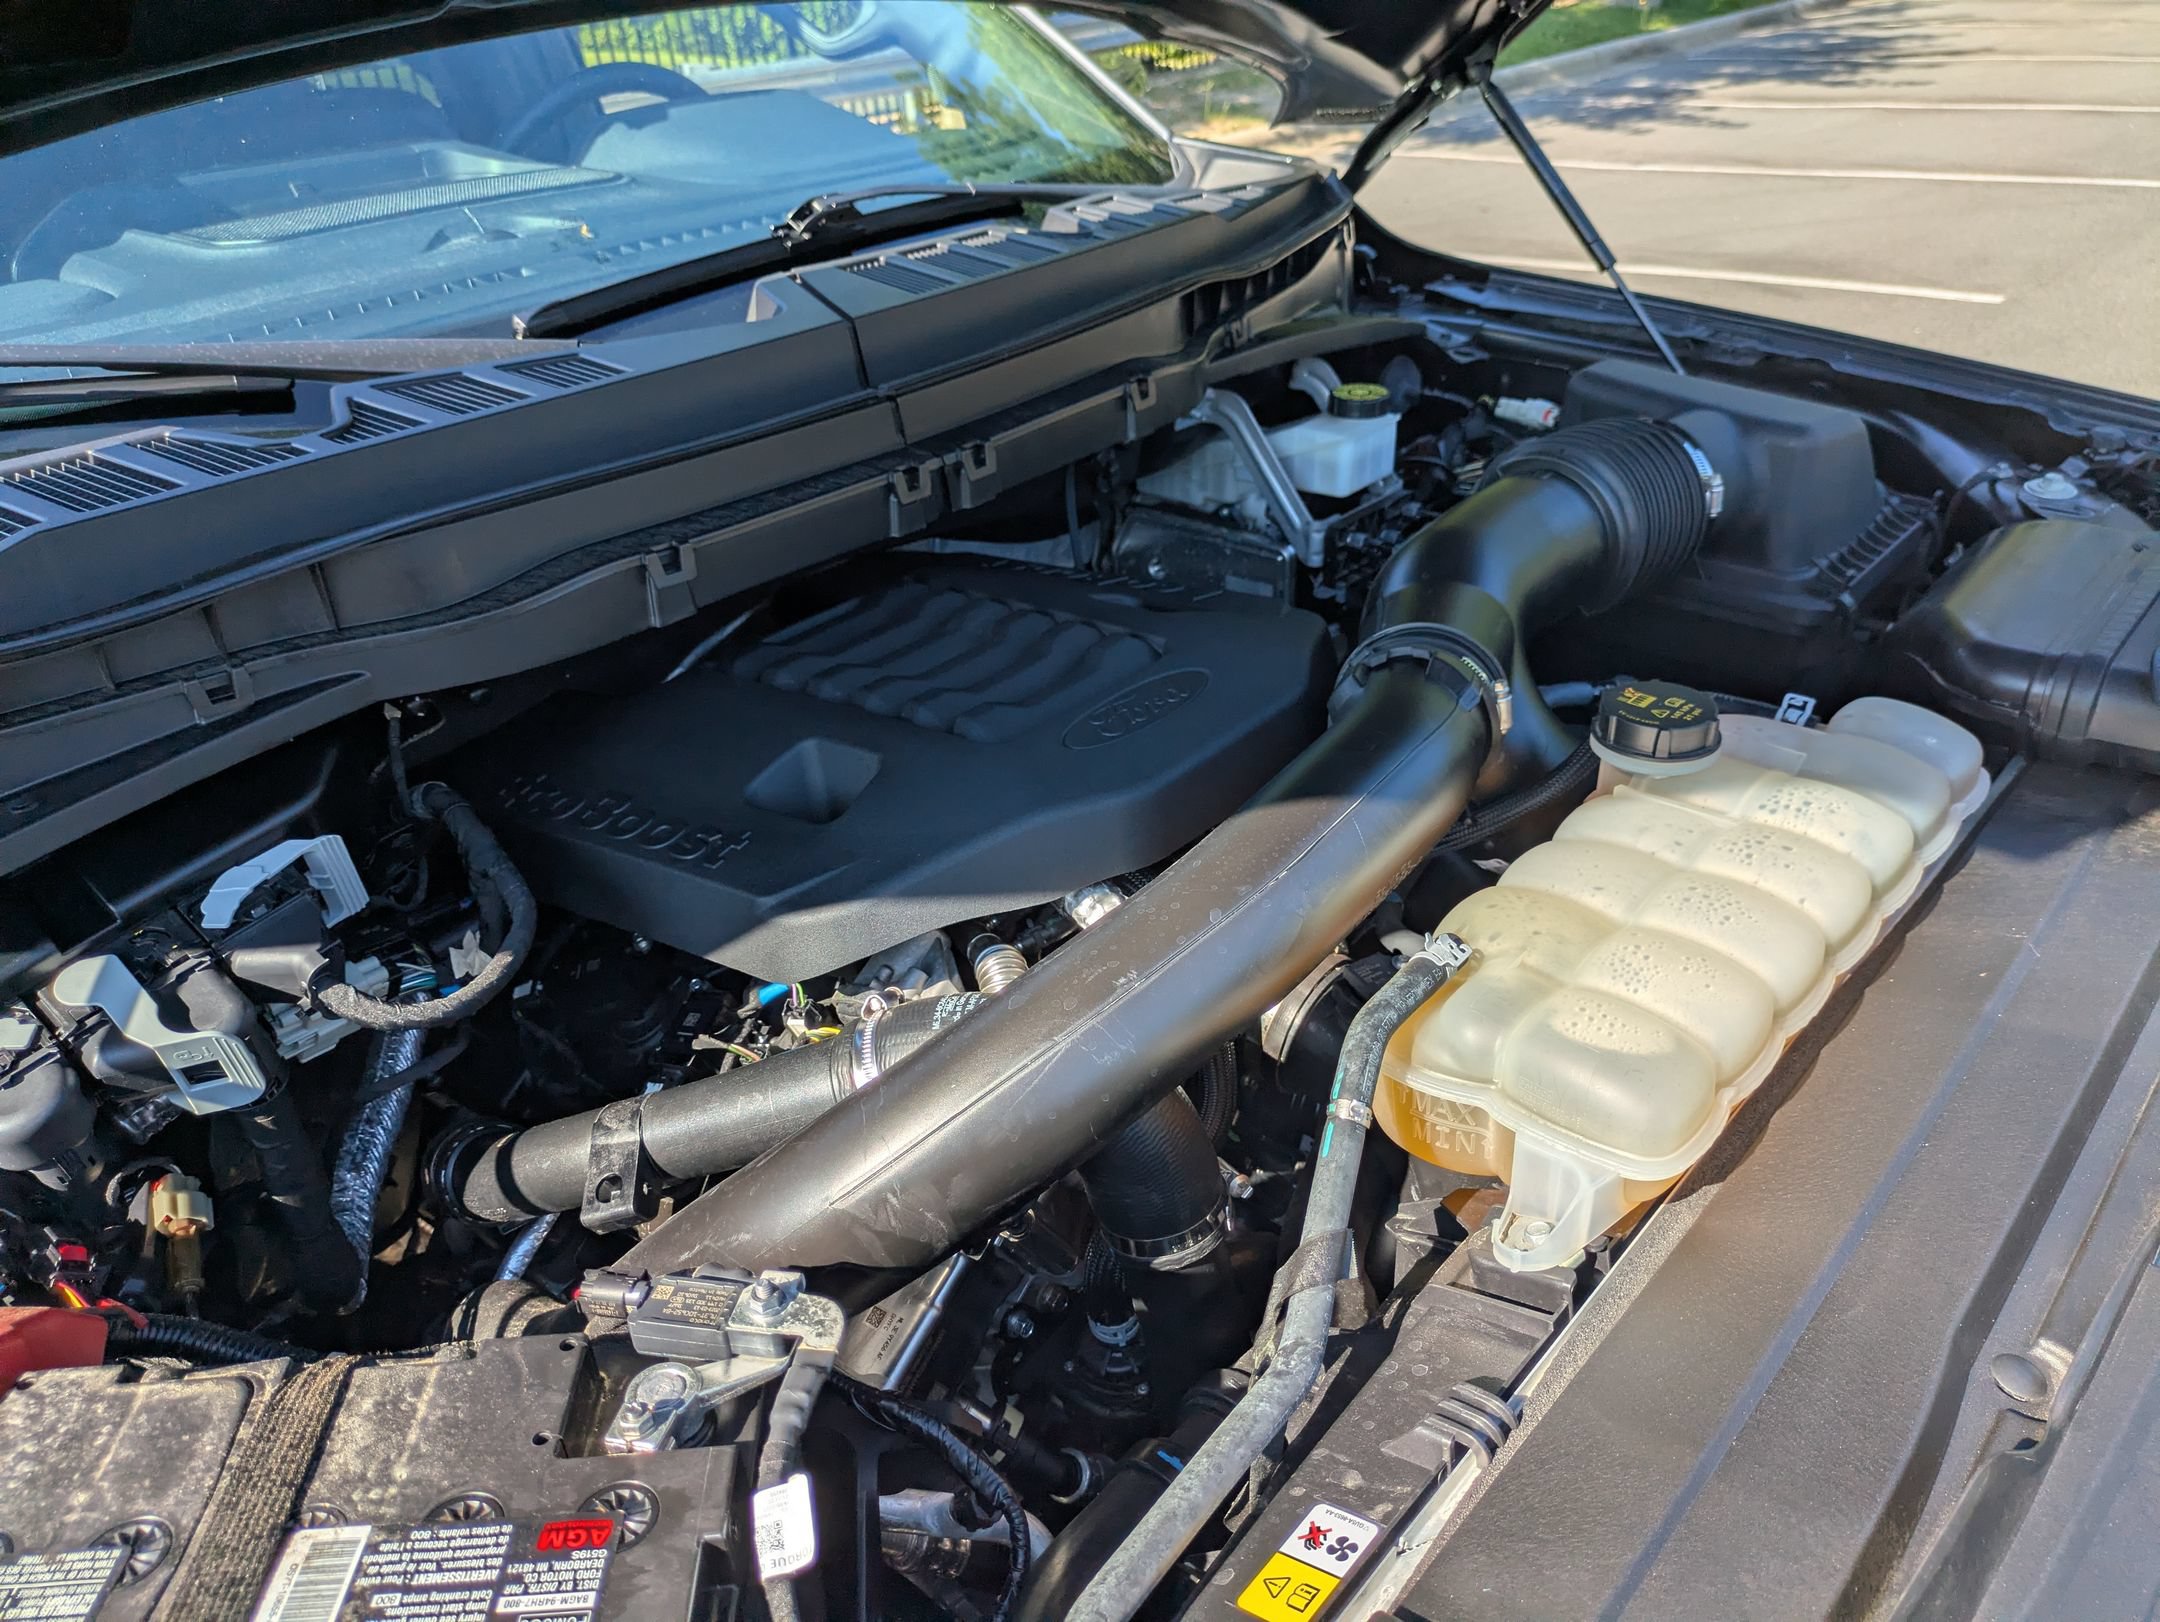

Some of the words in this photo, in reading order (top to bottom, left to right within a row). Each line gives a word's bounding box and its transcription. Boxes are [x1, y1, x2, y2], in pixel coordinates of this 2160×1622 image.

[1088, 688, 1190, 737] Ford
[1411, 1087, 1477, 1127] MAX
[1412, 1117, 1476, 1154] MIN
[438, 1528, 470, 1538] volants
[501, 1524, 513, 1534] de
[411, 1530, 431, 1540] 800
[498, 1535, 510, 1546] de
[538, 1528, 611, 1551] AGM
[413, 1540, 449, 1550] secours
[418, 1562, 437, 1572] Voir
[441, 1558, 485, 1569] blessures.
[486, 1557, 503, 1567] des
[536, 1562, 550, 1571] MI
[552, 1559, 605, 1571] DEARBORN,
[380, 1562, 408, 1574] guide
[507, 1563, 536, 1574] 48121
[66, 1571, 78, 1580] OF
[78, 1569, 94, 1579] OUT
[411, 1570, 500, 1585] AVERTISSEMENT
[523, 1573, 539, 1583] CO.
[540, 1570, 575, 1582] MOTOR
[576, 1569, 602, 1580] FORD
[383, 1575, 404, 1585] Pour
[560, 1580, 574, 1591] BY
[576, 1579, 600, 1590] DIST.
[503, 1583, 525, 1595] PAR
[528, 1581, 559, 1593] DISTR.
[402, 1592, 429, 1603] amps
[430, 1591, 471, 1602] cranking
[472, 1589, 493, 1600] Cold
[376, 1596, 398, 1605] 800
[465, 1600, 489, 1611] jump
[384, 1605, 441, 1616] instructions.
[442, 1602, 464, 1614] start
